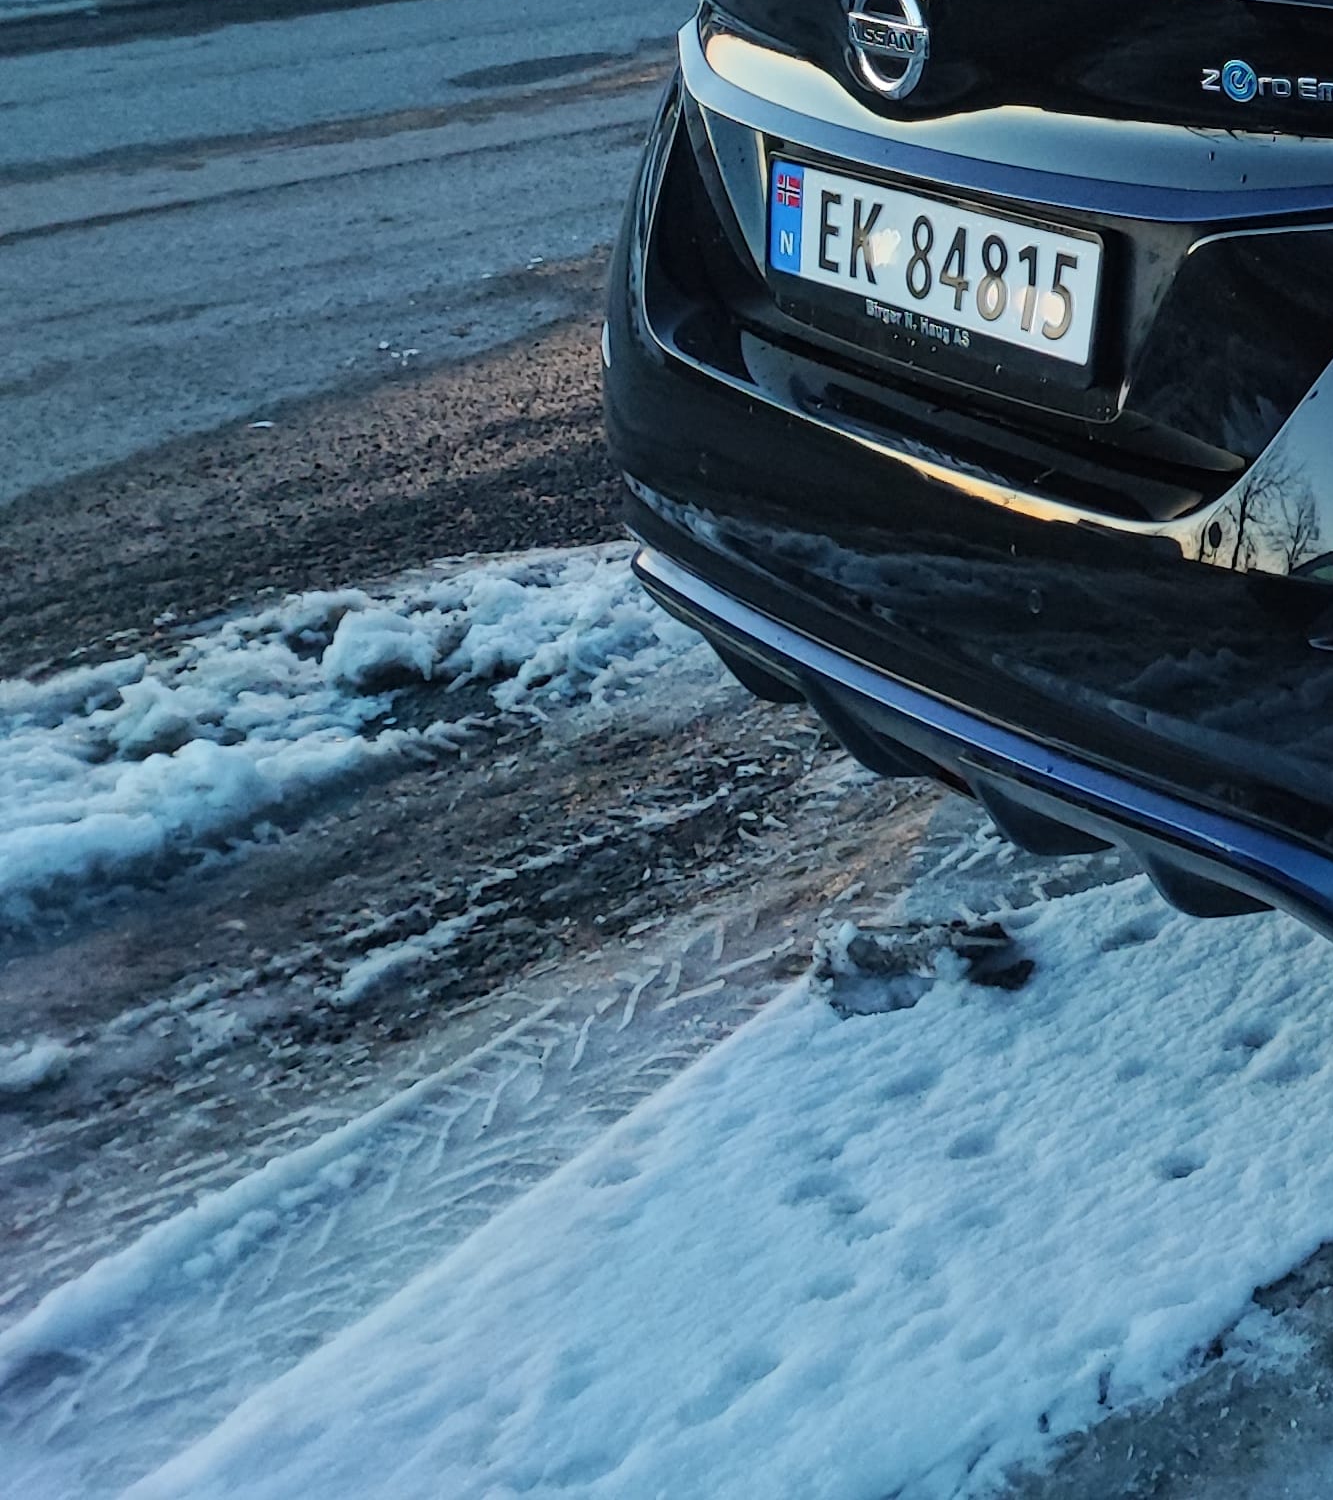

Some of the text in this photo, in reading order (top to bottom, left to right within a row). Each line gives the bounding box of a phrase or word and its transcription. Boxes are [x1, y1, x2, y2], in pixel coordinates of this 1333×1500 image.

[850, 20, 916, 53] NISSAN
[779, 229, 794, 256] N
[818, 189, 1078, 341] EK 84815
[919, 316, 951, 346] Haug
[952, 327, 971, 349] AS
